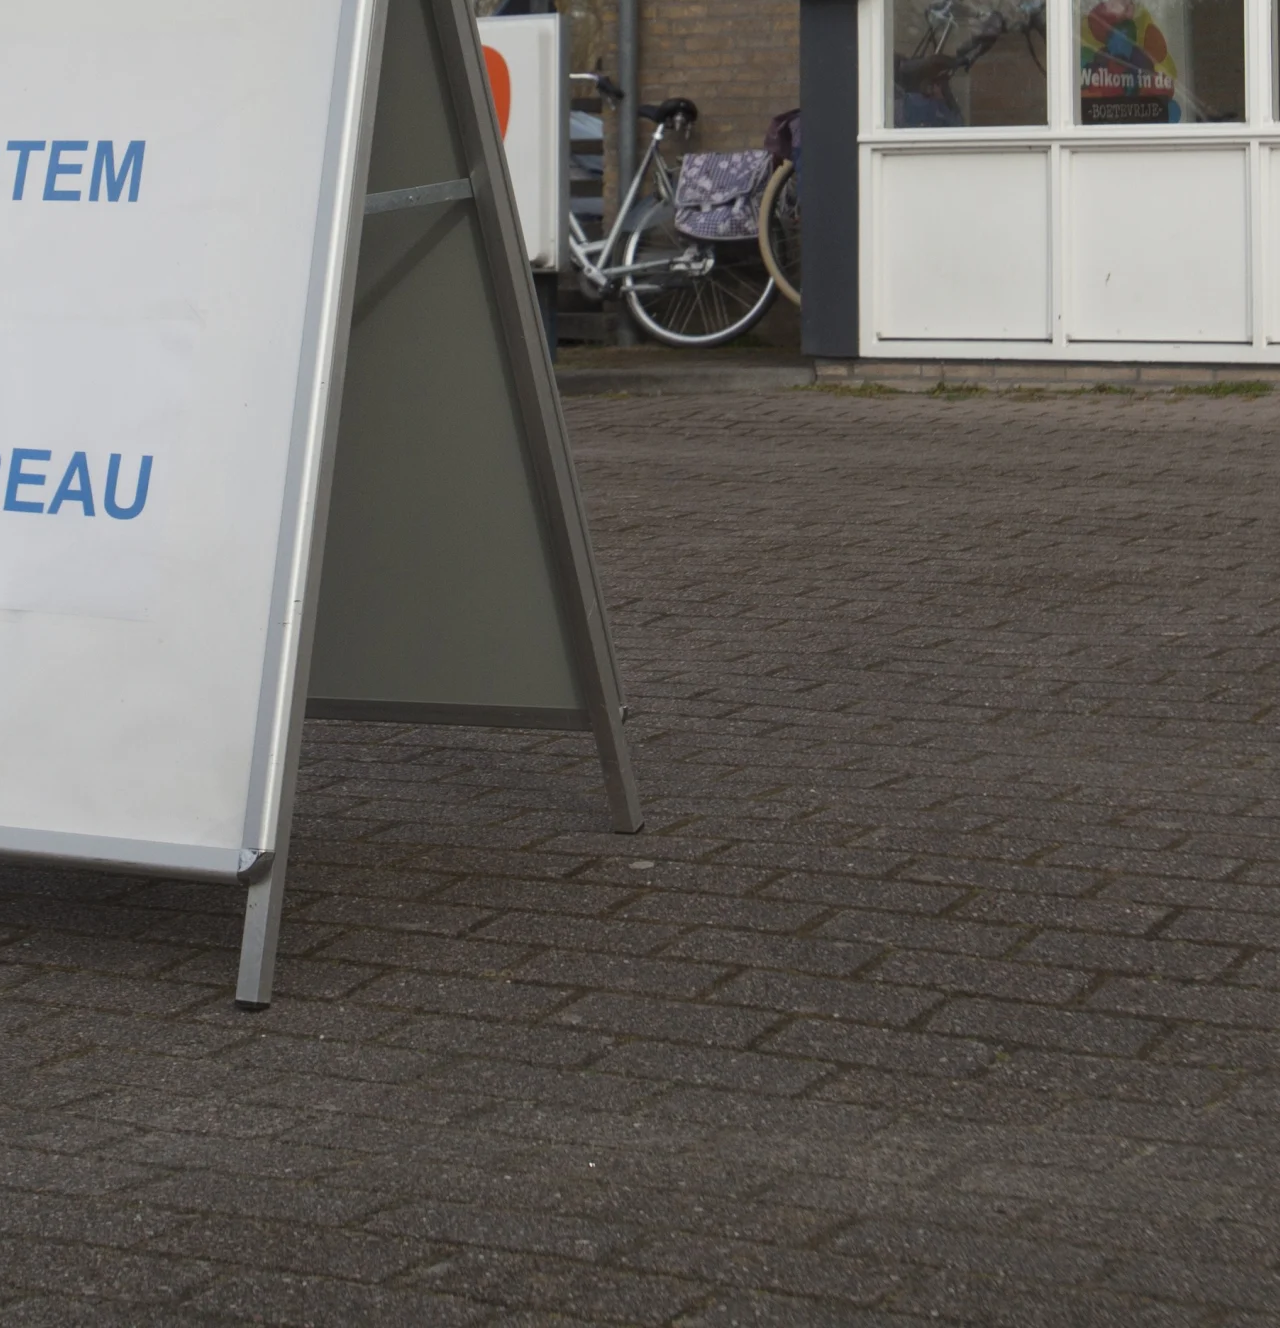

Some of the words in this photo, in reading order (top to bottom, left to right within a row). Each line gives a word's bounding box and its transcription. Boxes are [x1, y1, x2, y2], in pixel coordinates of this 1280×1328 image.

[1080, 67, 1135, 88] Welkom
[1137, 68, 1152, 89] in
[1154, 71, 1173, 90] de
